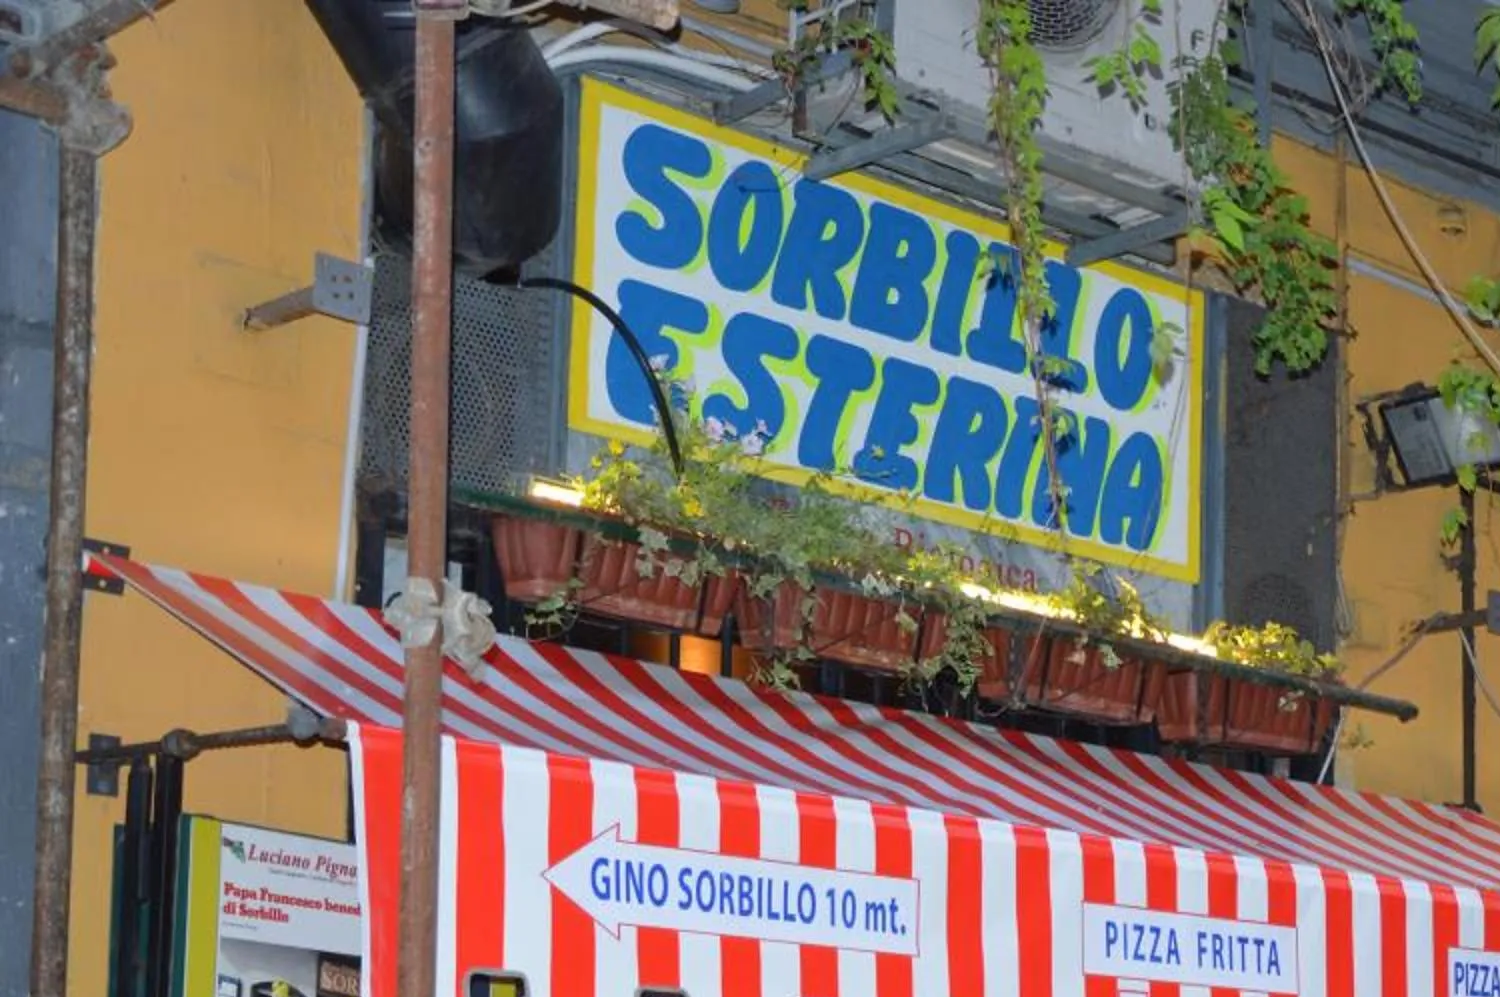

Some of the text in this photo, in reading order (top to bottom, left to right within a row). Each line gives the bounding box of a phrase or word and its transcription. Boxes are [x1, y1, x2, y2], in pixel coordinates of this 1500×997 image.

[615, 122, 1154, 411] SORBILLO
[606, 278, 1164, 552] ESTERINA
[247, 843, 310, 869] Luciano
[223, 881, 257, 900] Papa
[260, 887, 322, 909] Francesco
[223, 901, 289, 922] di Sorbillo
[590, 856, 907, 936] GINO SORBILLO 10 mt.
[1105, 920, 1281, 977] PIZZA FRITTA
